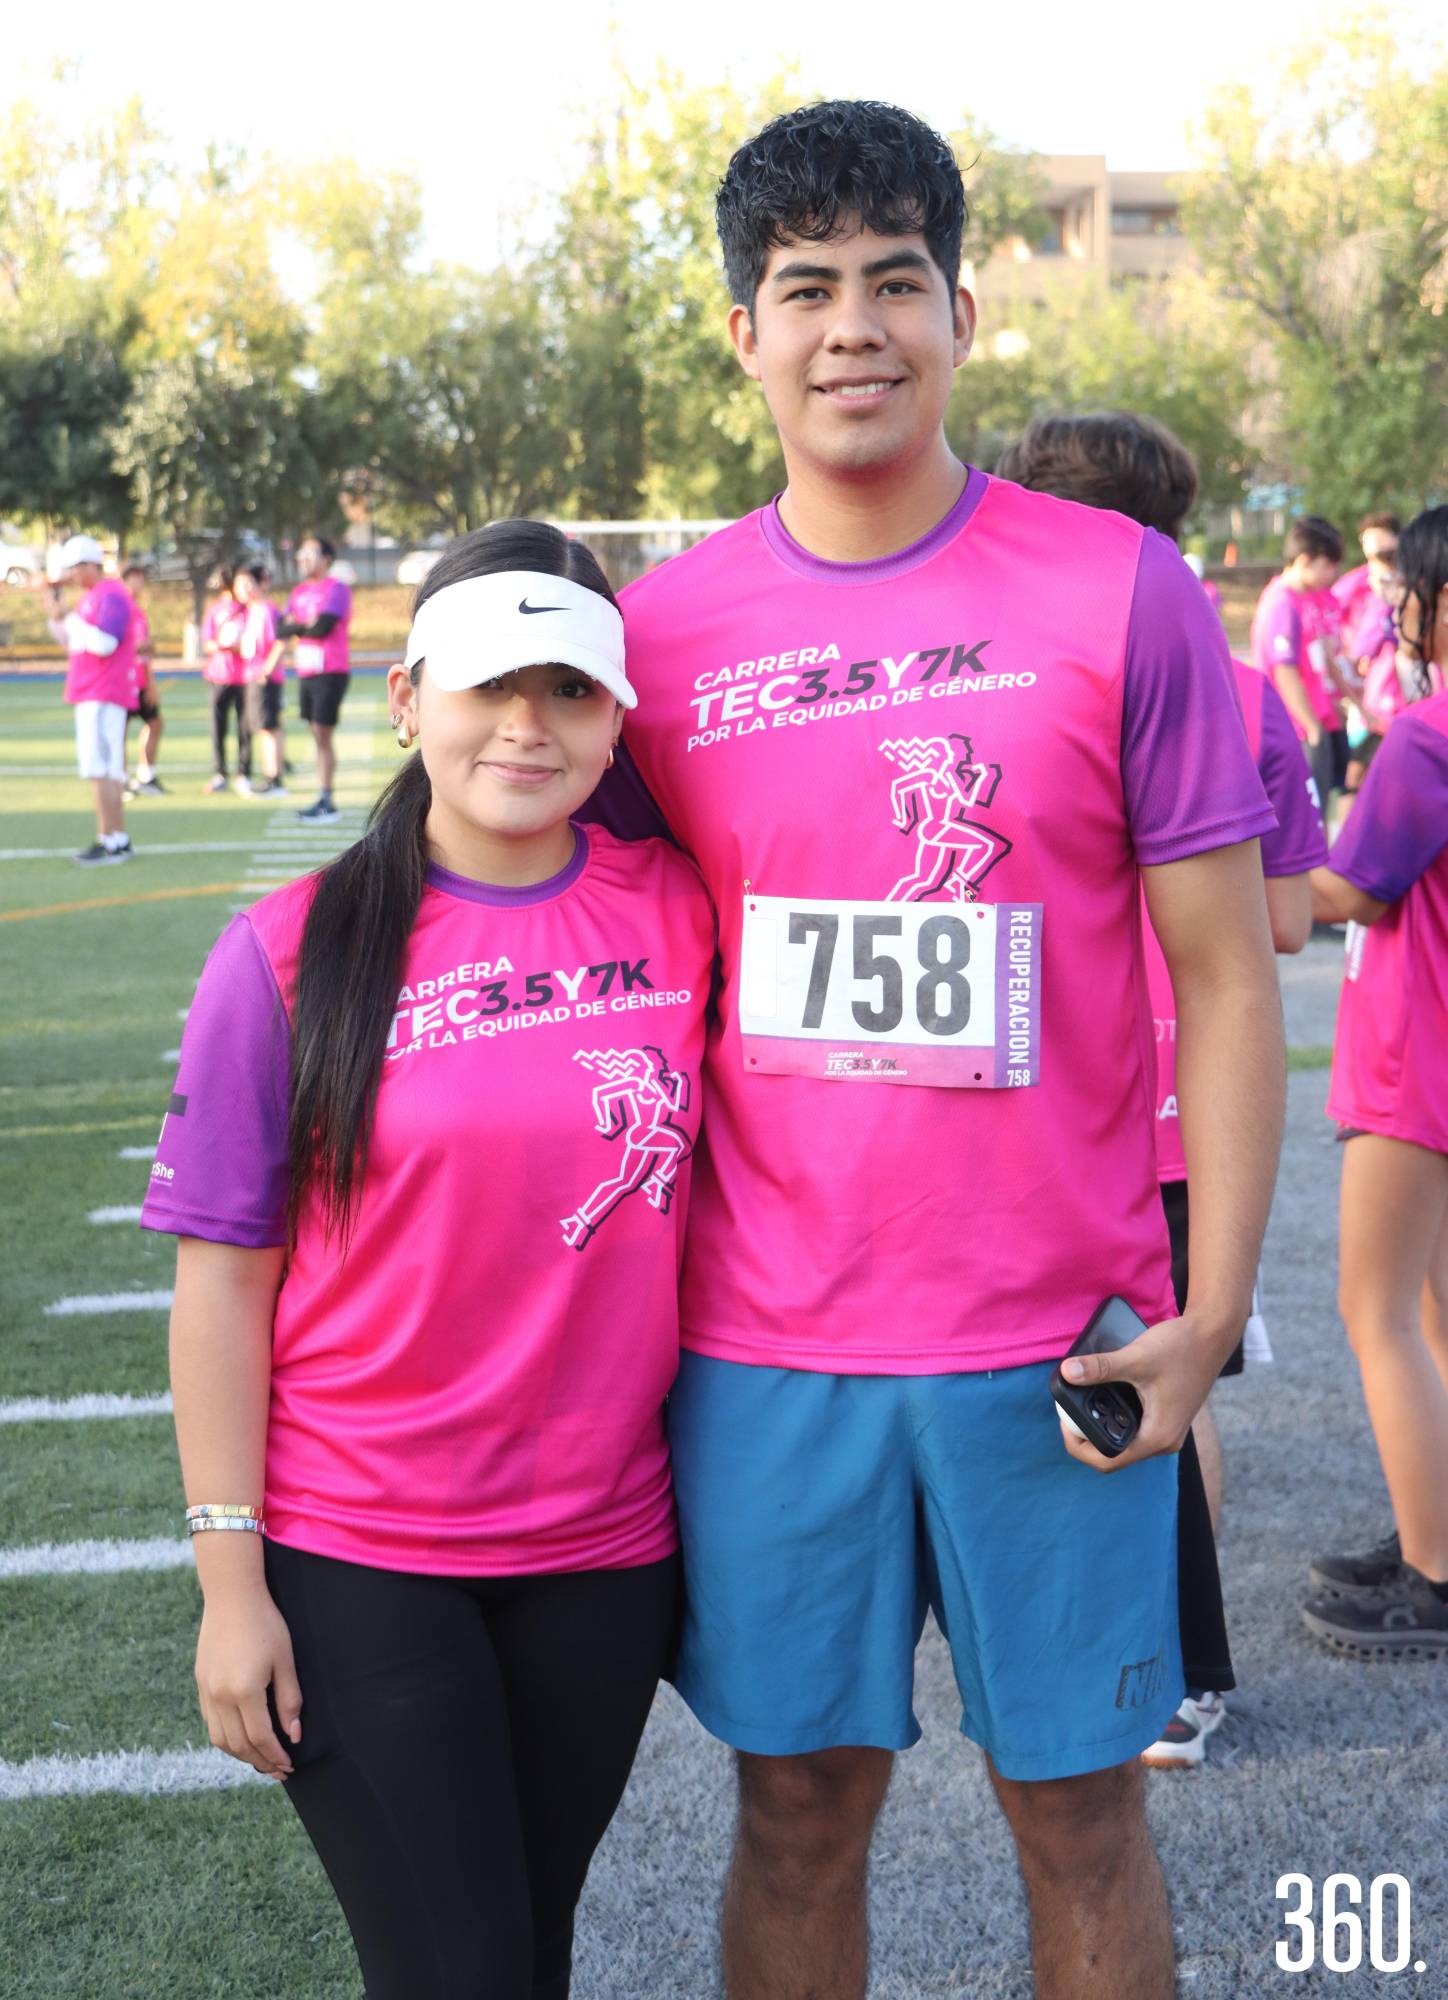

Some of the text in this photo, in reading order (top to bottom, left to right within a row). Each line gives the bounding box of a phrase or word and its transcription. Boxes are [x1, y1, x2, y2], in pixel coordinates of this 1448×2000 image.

[694, 643, 841, 691] CARRERA
[687, 671, 1037, 752] POR LA EQUIDAD DE GÉNERO
[397, 956, 515, 1004] ARRERA
[788, 911, 971, 1036] 758
[1008, 911, 1032, 1064] RECUPERACION
[384, 989, 692, 1060] OR LA EQUIDAD DE GÉNERO
[1007, 1070, 1030, 1086] 758
